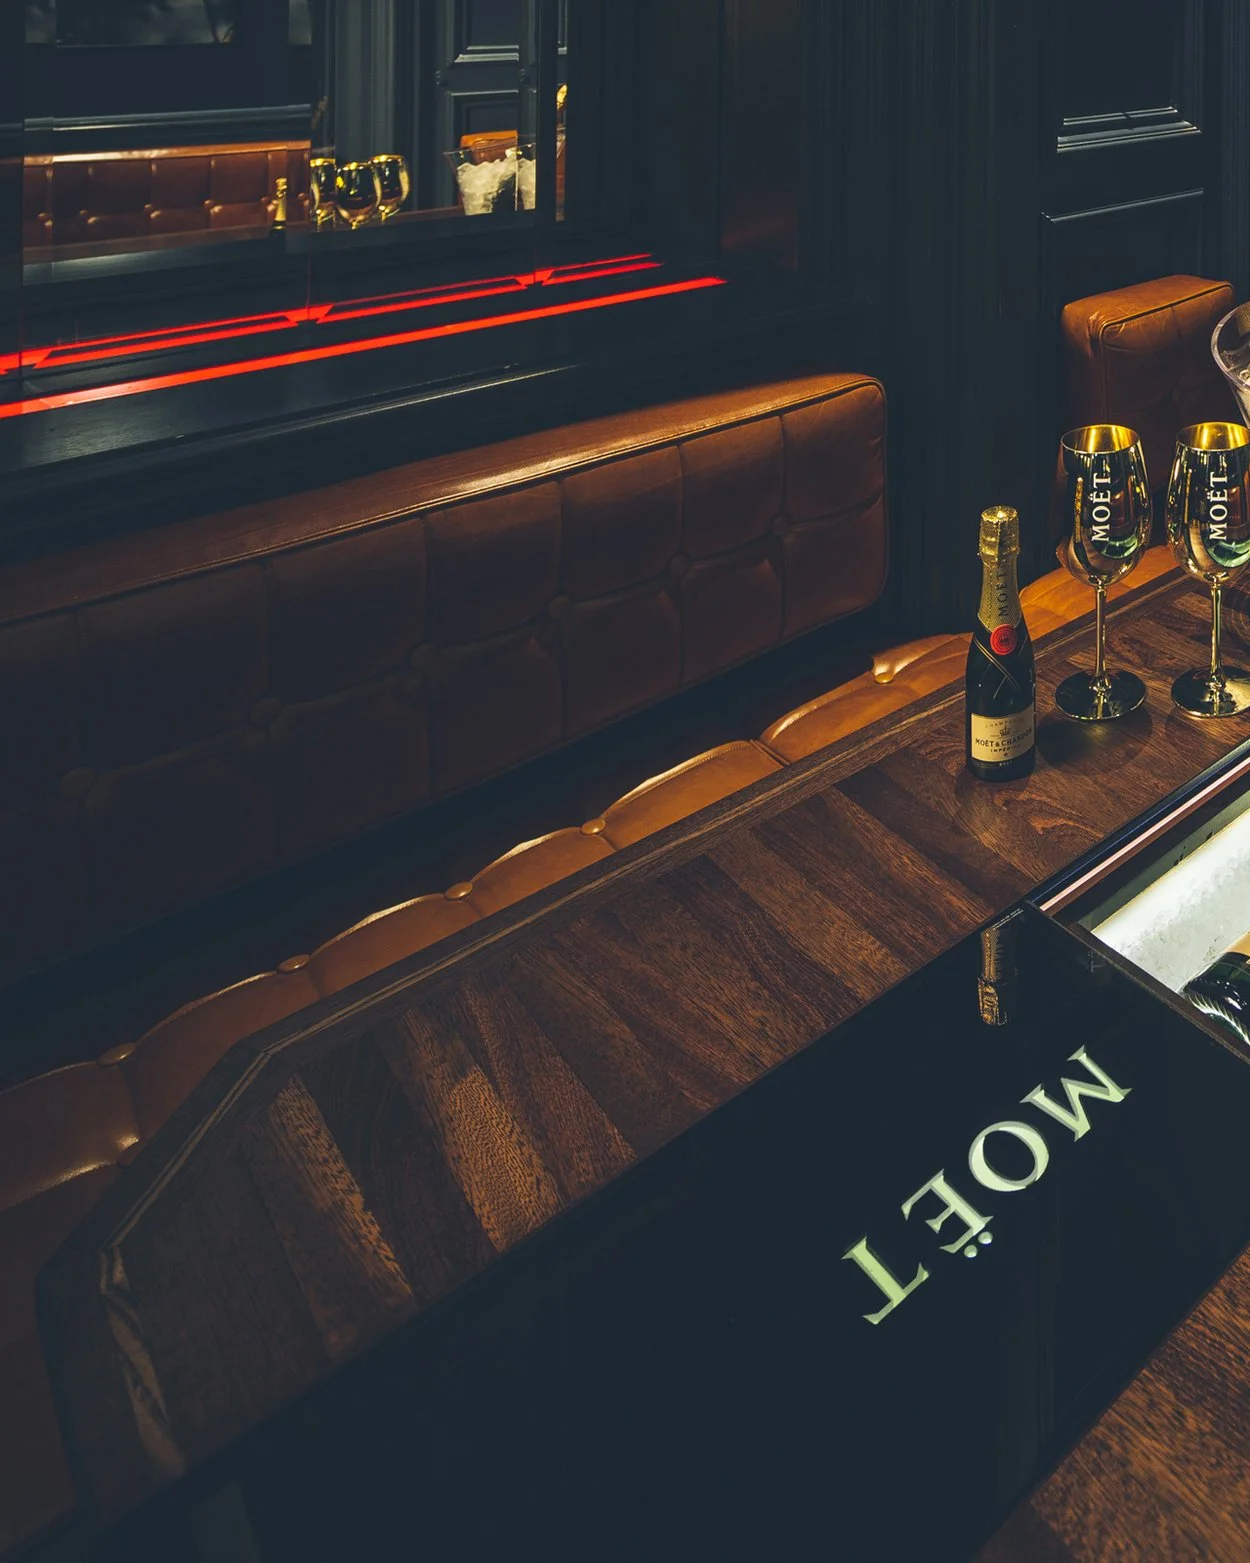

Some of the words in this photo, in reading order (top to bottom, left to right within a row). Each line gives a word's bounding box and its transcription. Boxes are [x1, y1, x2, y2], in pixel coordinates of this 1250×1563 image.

[1090, 472, 1111, 542] MOËT
[1207, 471, 1228, 541] MOËT
[840, 1044, 1133, 1326] MOËT
